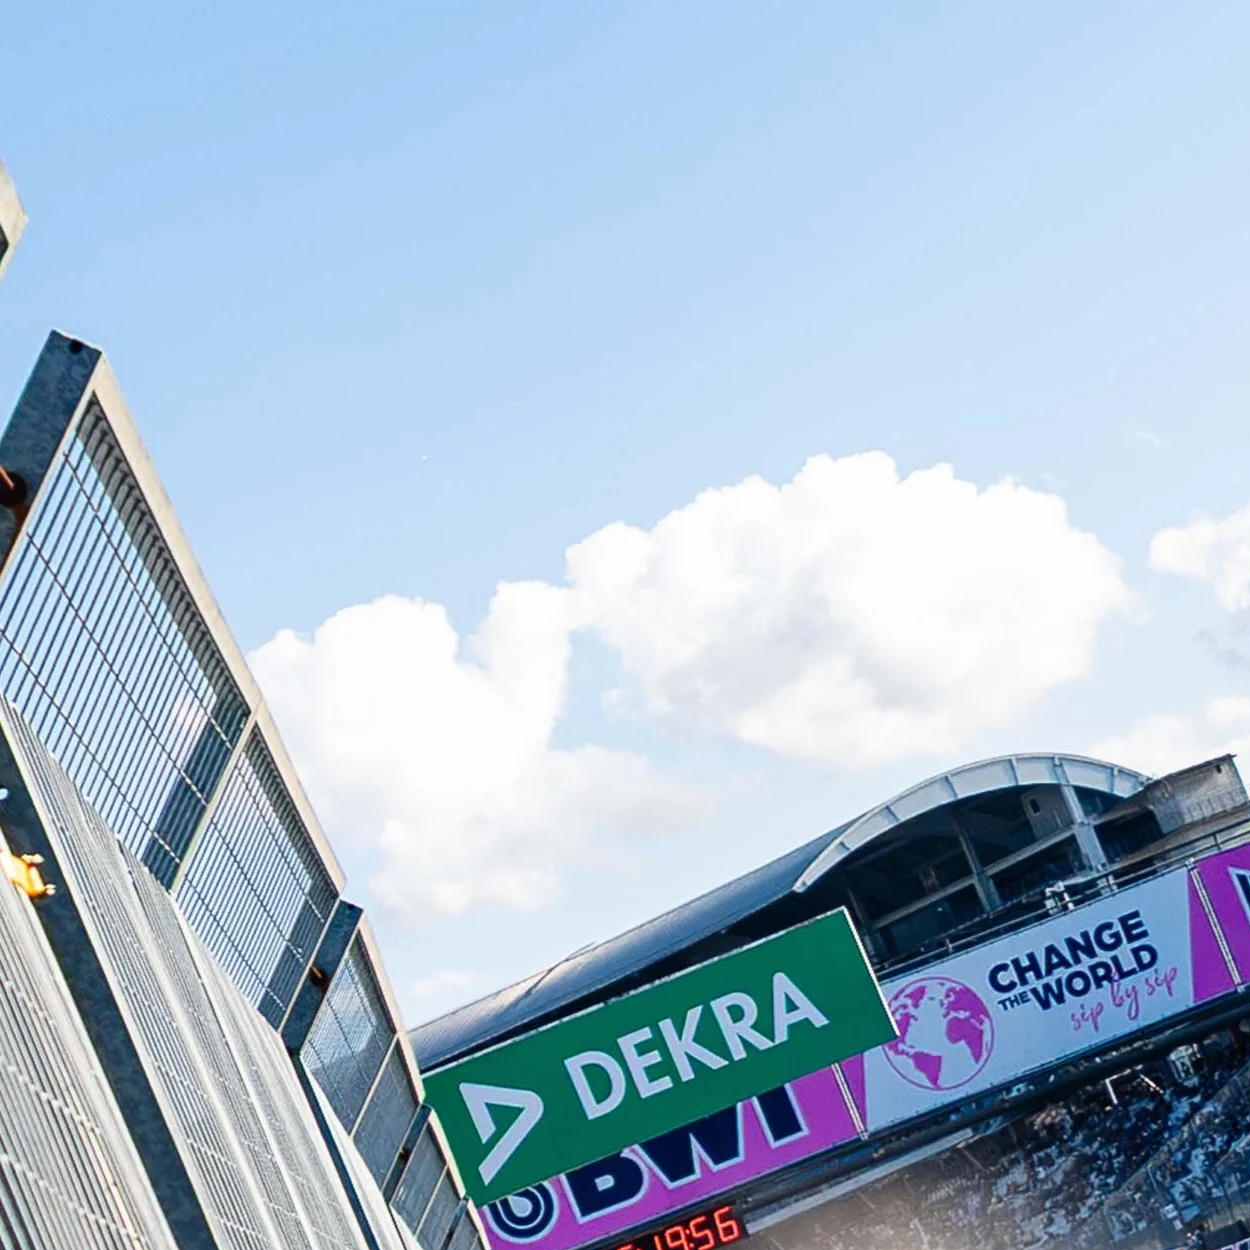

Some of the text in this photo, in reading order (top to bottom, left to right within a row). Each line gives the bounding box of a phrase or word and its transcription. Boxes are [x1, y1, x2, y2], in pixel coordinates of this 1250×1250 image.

[987, 910, 1150, 994] CHANGE
[997, 943, 1159, 1013] THE WORLD
[1071, 1003, 1104, 1033] sip
[1146, 966, 1178, 997] sip
[563, 971, 830, 1122] DEKRA
